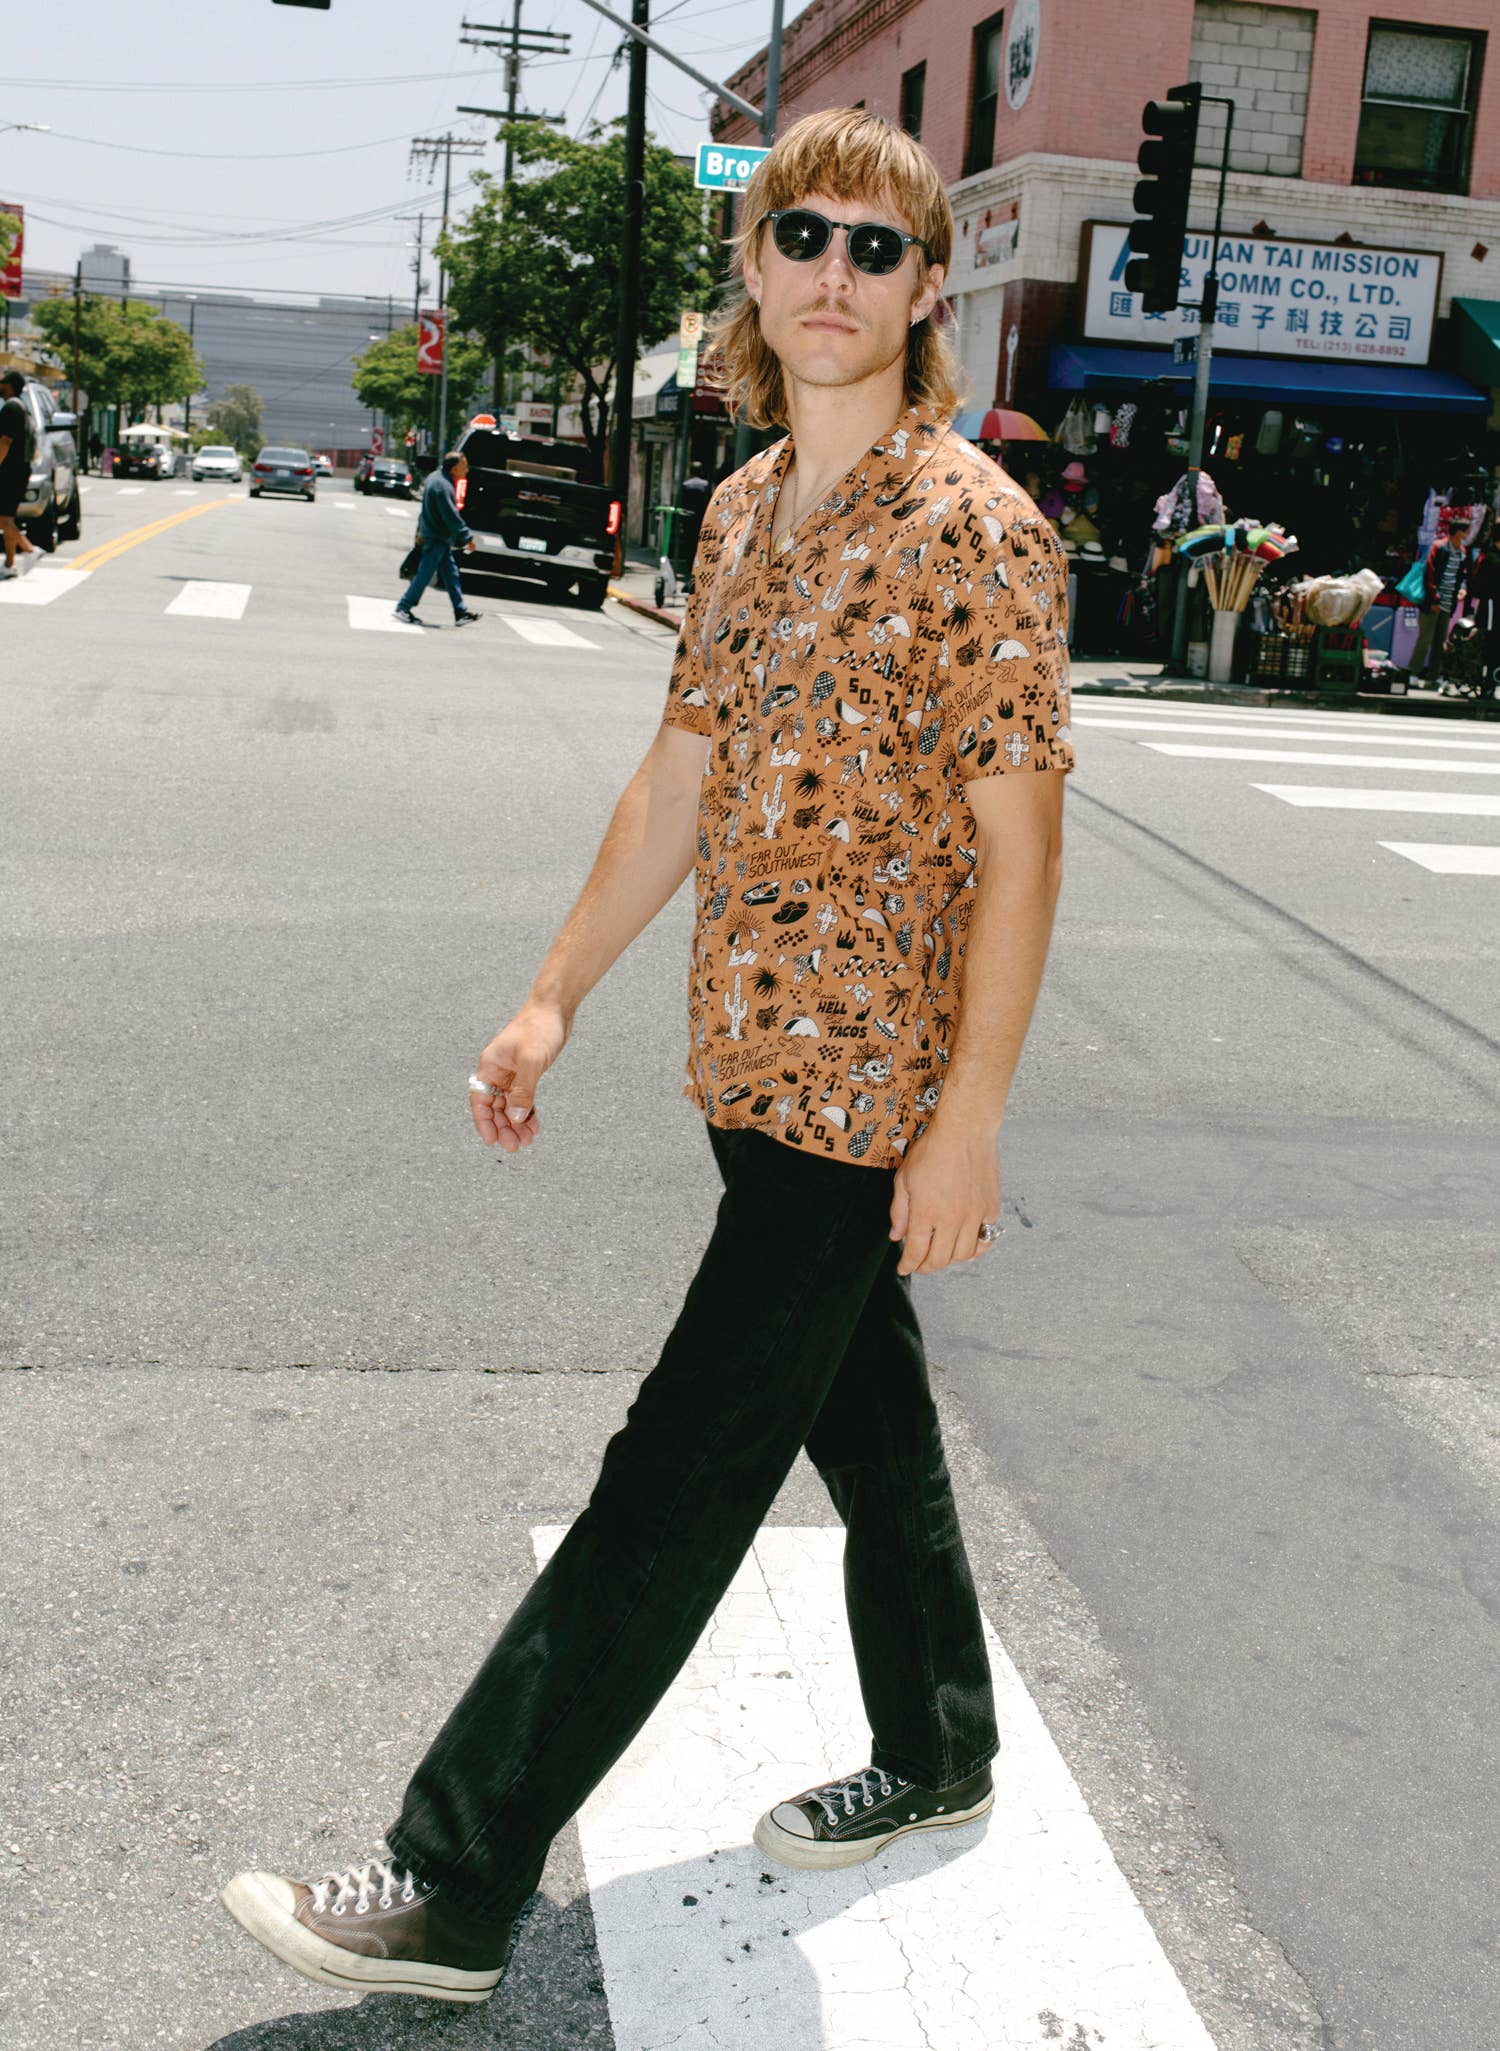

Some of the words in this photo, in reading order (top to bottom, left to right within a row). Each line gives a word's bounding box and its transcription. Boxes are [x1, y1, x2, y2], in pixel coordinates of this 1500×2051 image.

[1183, 237, 1209, 259] UI
[1264, 246, 1303, 268] TAI
[1312, 250, 1419, 278] MISSION
[1205, 271, 1281, 296] OMM
[1290, 278, 1338, 305] CO.,
[1348, 283, 1400, 306] LTD.
[1109, 291, 1412, 341] 匯泰電子科技公司
[958, 487, 987, 564] TACOS
[884, 690, 914, 756] TACOS
[948, 682, 993, 733] SOUTHWEST
[1021, 714, 1075, 769] TACOS
[851, 803, 881, 823] HELL
[859, 829, 893, 846] TACOS
[748, 851, 823, 879] SOUTHWEST
[750, 849, 771, 866] FAR
[774, 842, 801, 859] OUT
[816, 1000, 848, 1015] HELL
[827, 1025, 869, 1039] TACOS
[719, 1051, 740, 1067] FAR
[741, 1045, 763, 1061] OUT
[719, 1052, 781, 1082] SOUTHWEST
[797, 1085, 836, 1153] TACOS
